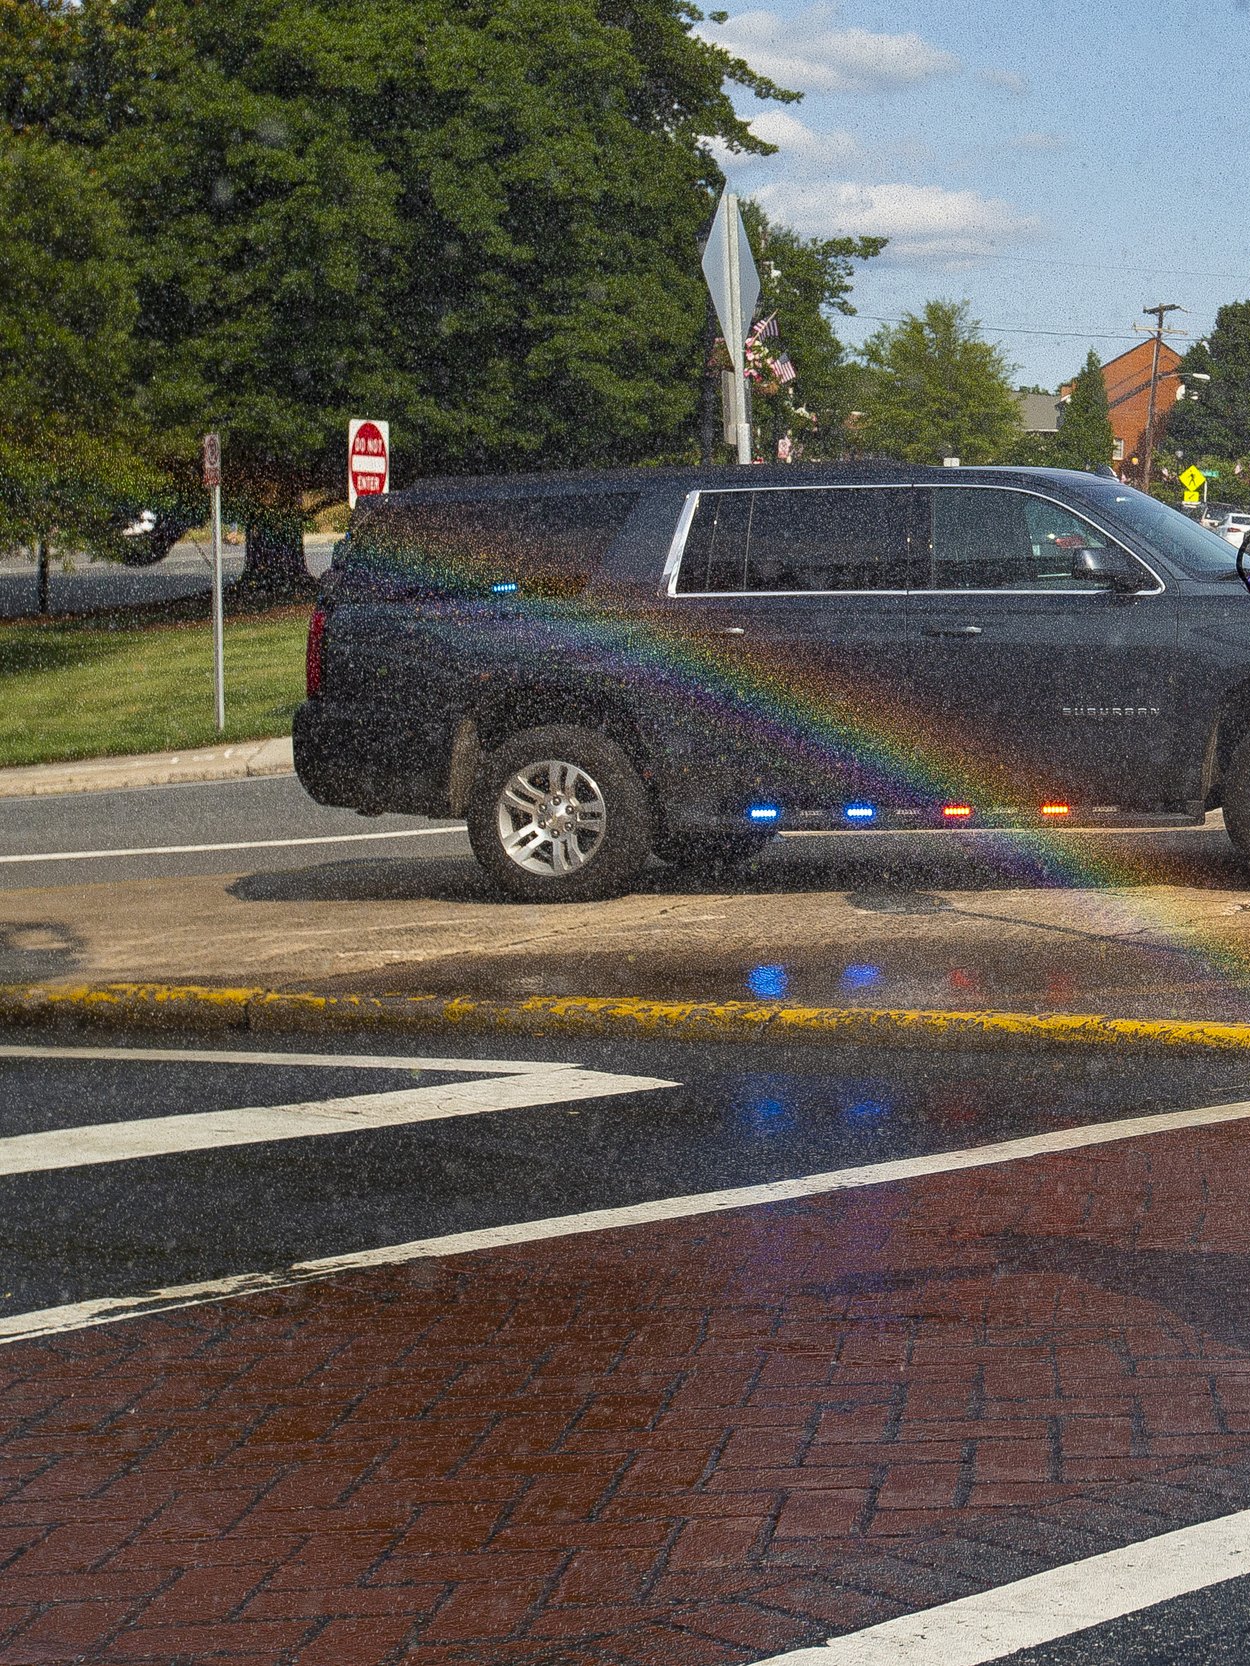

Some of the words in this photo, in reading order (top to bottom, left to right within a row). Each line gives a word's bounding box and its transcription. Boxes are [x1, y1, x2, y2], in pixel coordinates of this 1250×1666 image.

[354, 437, 366, 453] DO
[367, 437, 382, 454] NOT
[357, 475, 380, 491] ENTER
[1062, 707, 1160, 716] SUBURBAN
